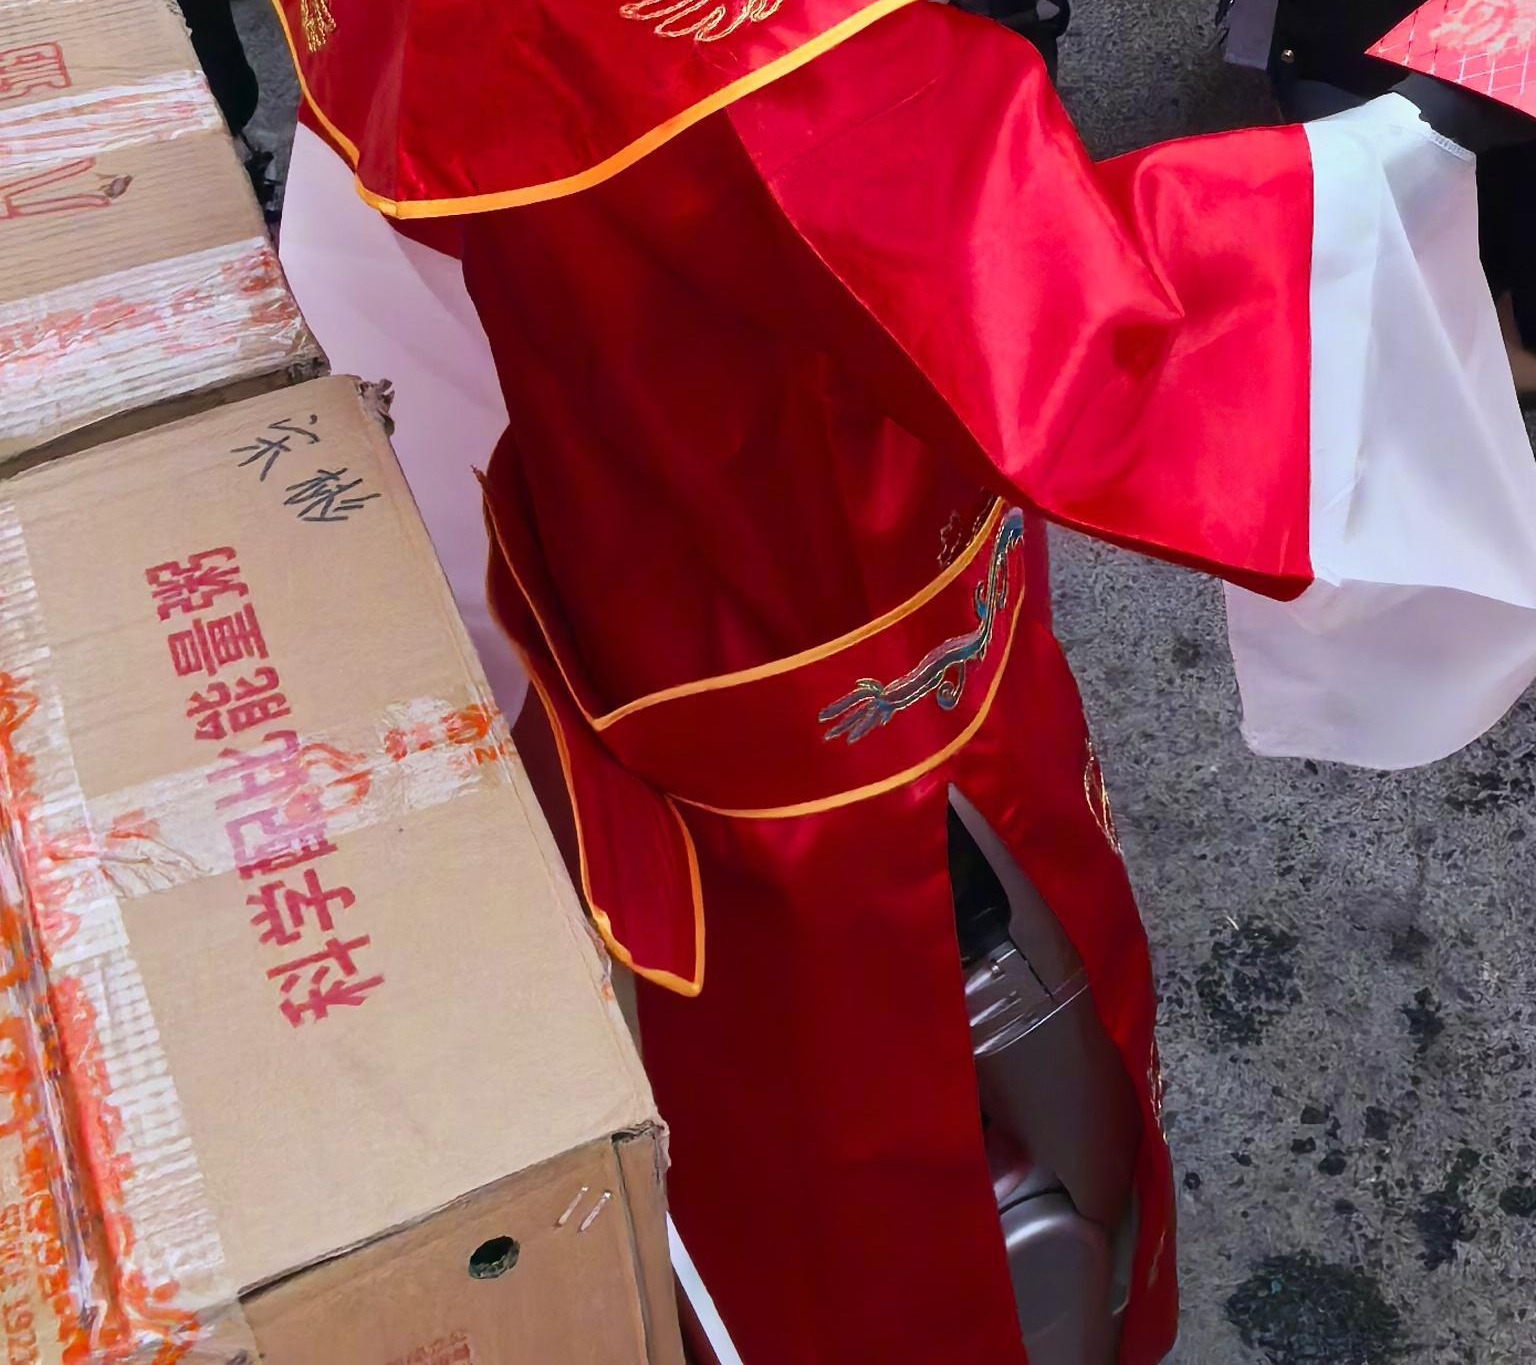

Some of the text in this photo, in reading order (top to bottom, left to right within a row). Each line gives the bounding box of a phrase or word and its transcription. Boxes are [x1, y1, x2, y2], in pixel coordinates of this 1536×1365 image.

[146, 546, 385, 1029] 科学配比能量粥
